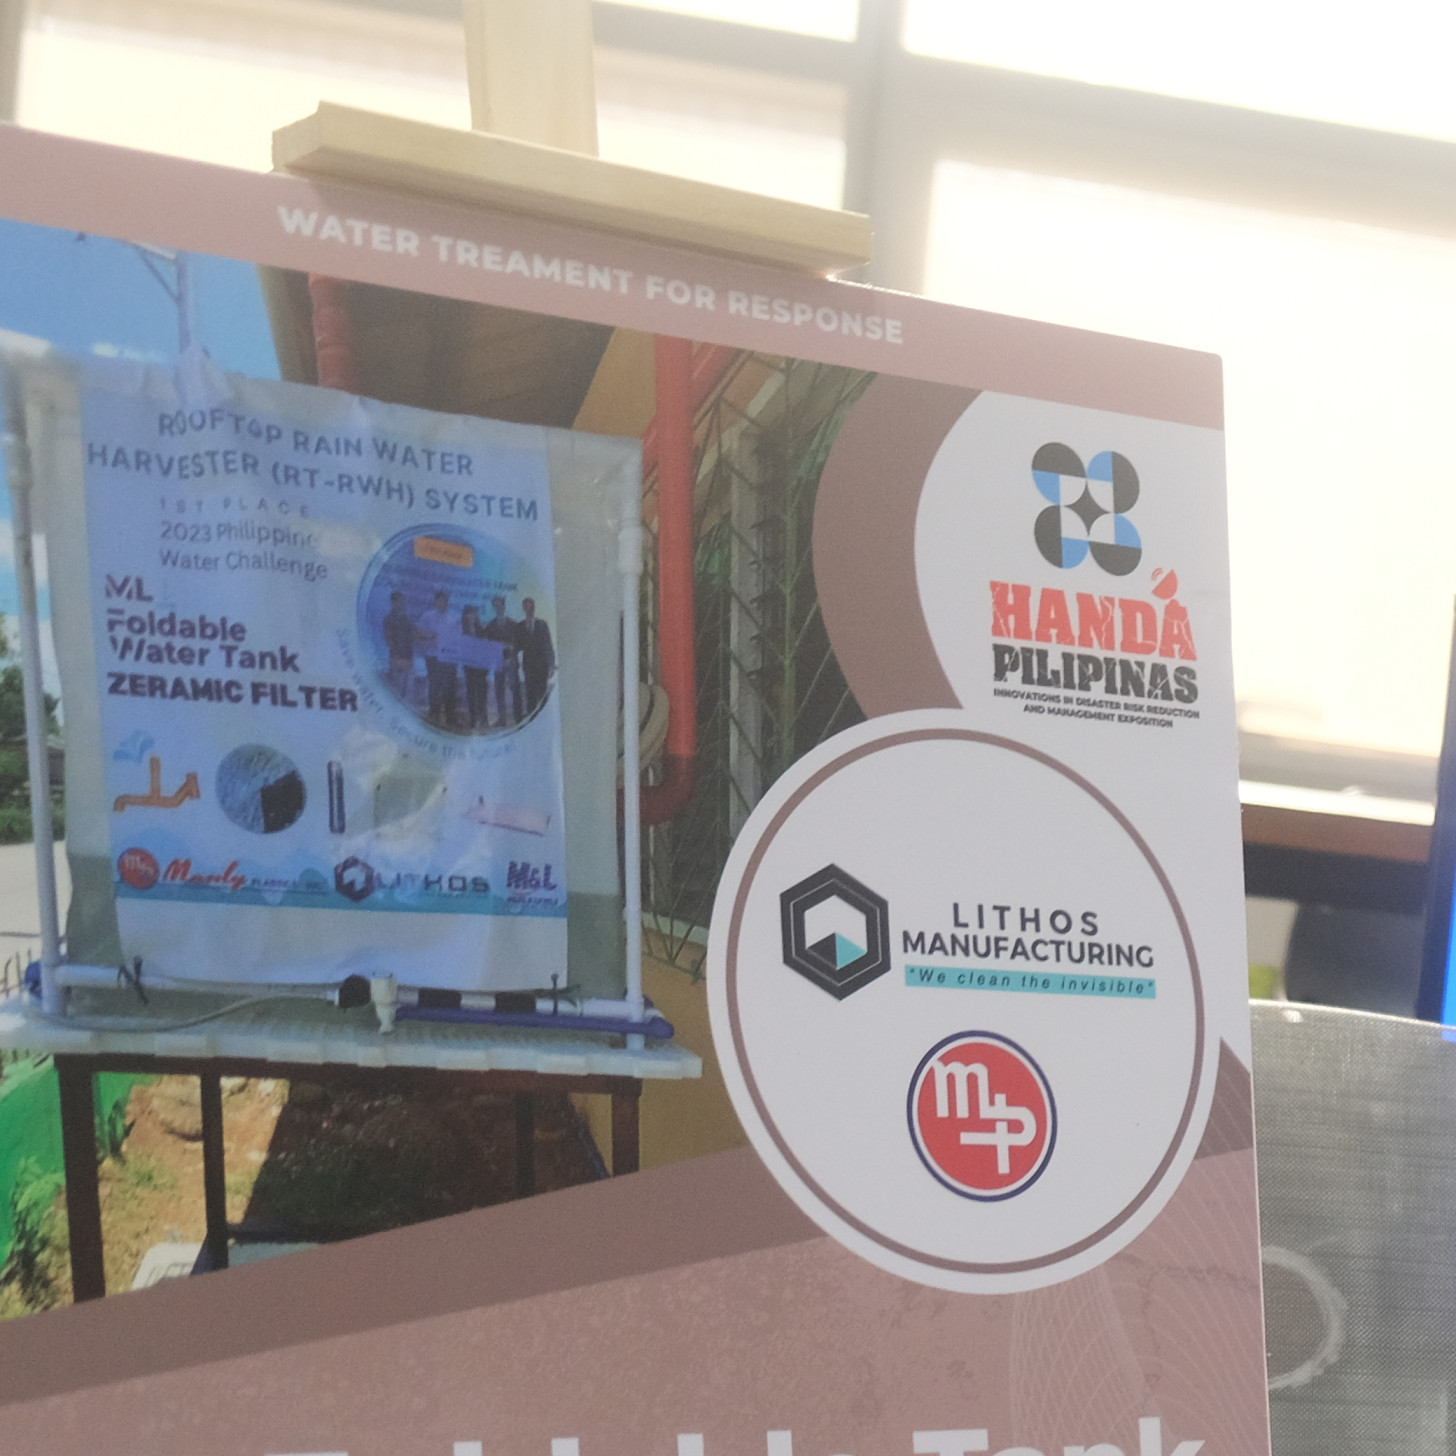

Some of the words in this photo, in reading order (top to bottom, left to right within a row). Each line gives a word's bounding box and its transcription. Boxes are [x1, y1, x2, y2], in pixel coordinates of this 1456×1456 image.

[278, 206, 420, 258] WATER
[432, 234, 633, 295] TREAMENT
[646, 276, 716, 312] FOR
[728, 290, 904, 344] RESPONSE
[294, 429, 362, 459] RAIN
[373, 438, 472, 476] WATER
[87, 442, 259, 478] HARVESTER
[272, 460, 416, 510] (RT-RWH)
[424, 488, 539, 521] SYSTEM
[160, 520, 211, 542] 2023
[159, 550, 219, 571] Water
[225, 551, 327, 582] Challenge
[105, 574, 153, 602] ML
[107, 608, 247, 642] Foldable
[110, 635, 210, 667] Water
[220, 645, 300, 673] Tank
[992, 643, 1198, 704] PILIPINAS
[107, 672, 244, 702] ZERAMIC
[251, 682, 358, 712] FILTER
[994, 688, 1062, 704] INNOVATIONS
[1063, 696, 1074, 705] IN
[1076, 697, 1121, 710] DISASTER
[1124, 703, 1145, 712] RISK
[1147, 705, 1200, 719] REDUCTION
[1024, 704, 1046, 714] AND
[1047, 707, 1114, 722] MANAGEMENT
[1118, 716, 1173, 728] EXPOSITION
[953, 902, 1099, 936] LITHOS
[902, 930, 1154, 968] MANUFACTURING
[957, 972, 1010, 987] clean
[1021, 976, 1050, 989] the
